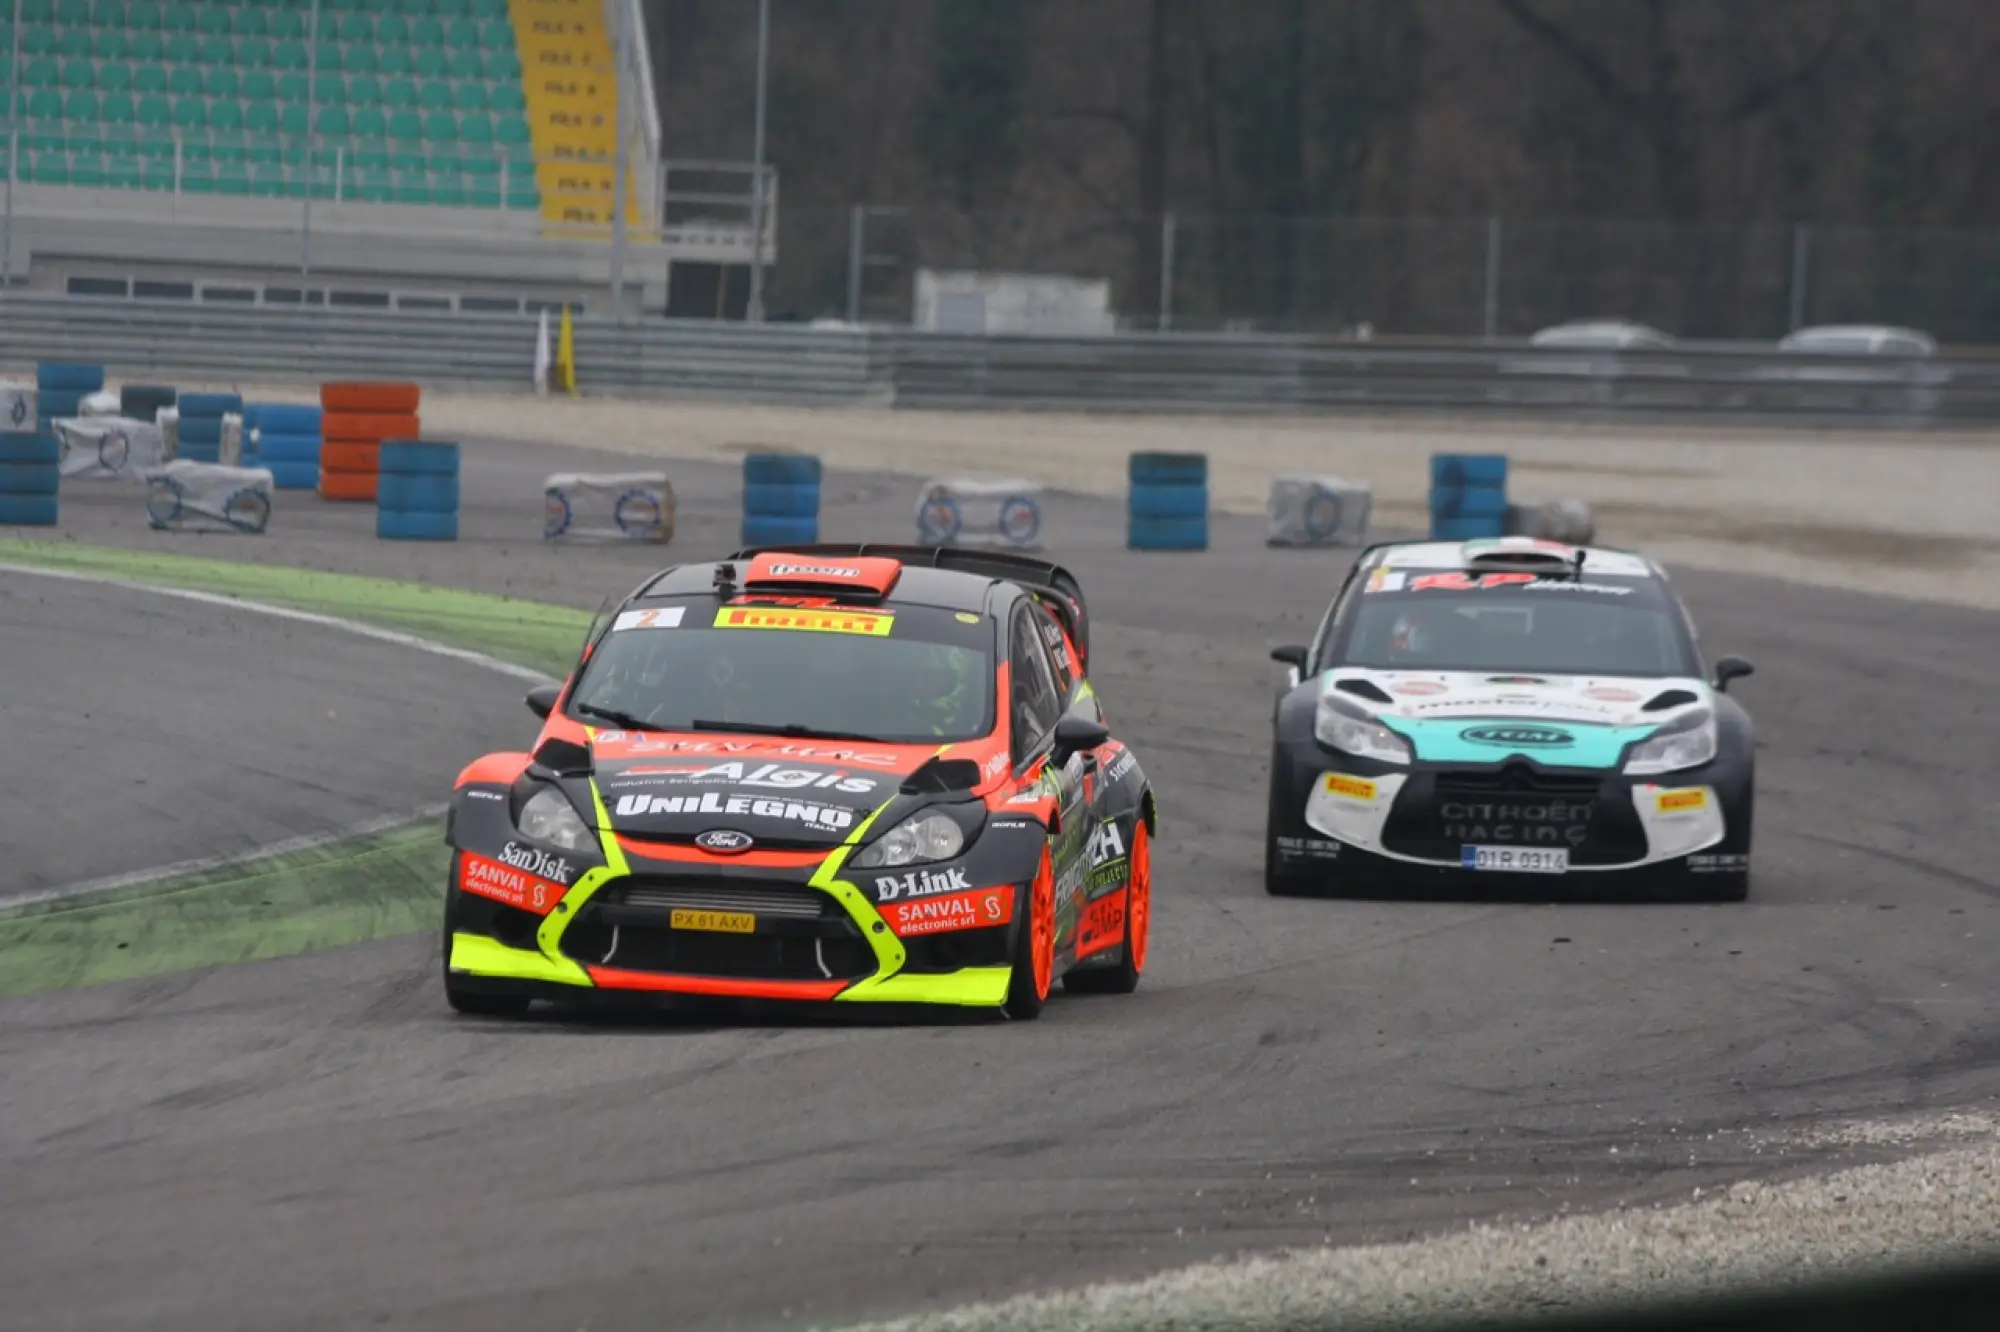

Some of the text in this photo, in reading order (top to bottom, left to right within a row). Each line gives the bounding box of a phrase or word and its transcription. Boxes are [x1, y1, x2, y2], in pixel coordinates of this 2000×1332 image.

[728, 609, 880, 633] PIRELLI
[707, 833, 739, 846] Ford
[497, 841, 568, 884] SanDisk
[468, 861, 526, 891] SANVAL
[875, 868, 973, 901] D-Link
[465, 879, 510, 900] electronic
[674, 913, 695, 927] PX
[719, 915, 750, 931] AXV
[898, 898, 976, 922] SANVAL
[901, 914, 975, 934] electronic srl
